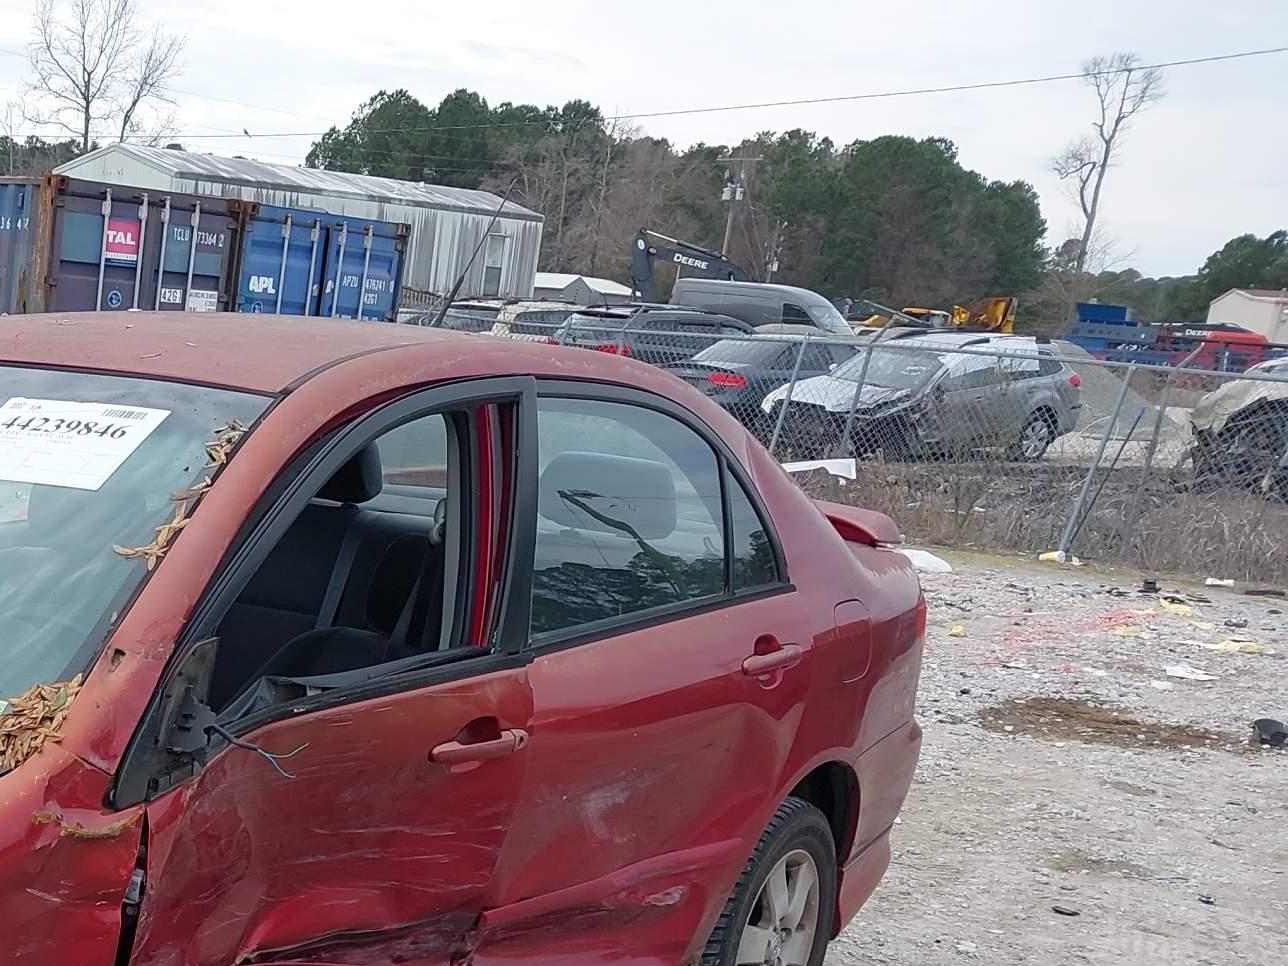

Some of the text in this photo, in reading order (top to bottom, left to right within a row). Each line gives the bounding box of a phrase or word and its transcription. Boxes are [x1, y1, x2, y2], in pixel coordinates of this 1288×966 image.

[106, 230, 136, 246] TAL
[173, 227, 190, 242] TCLU
[197, 231, 217, 247] 73364
[673, 252, 710, 270] DEERE
[248, 275, 276, 295] APL
[161, 288, 183, 304] 42G1
[1185, 328, 1210, 337] DEER
[1, 415, 134, 440] 44239846
